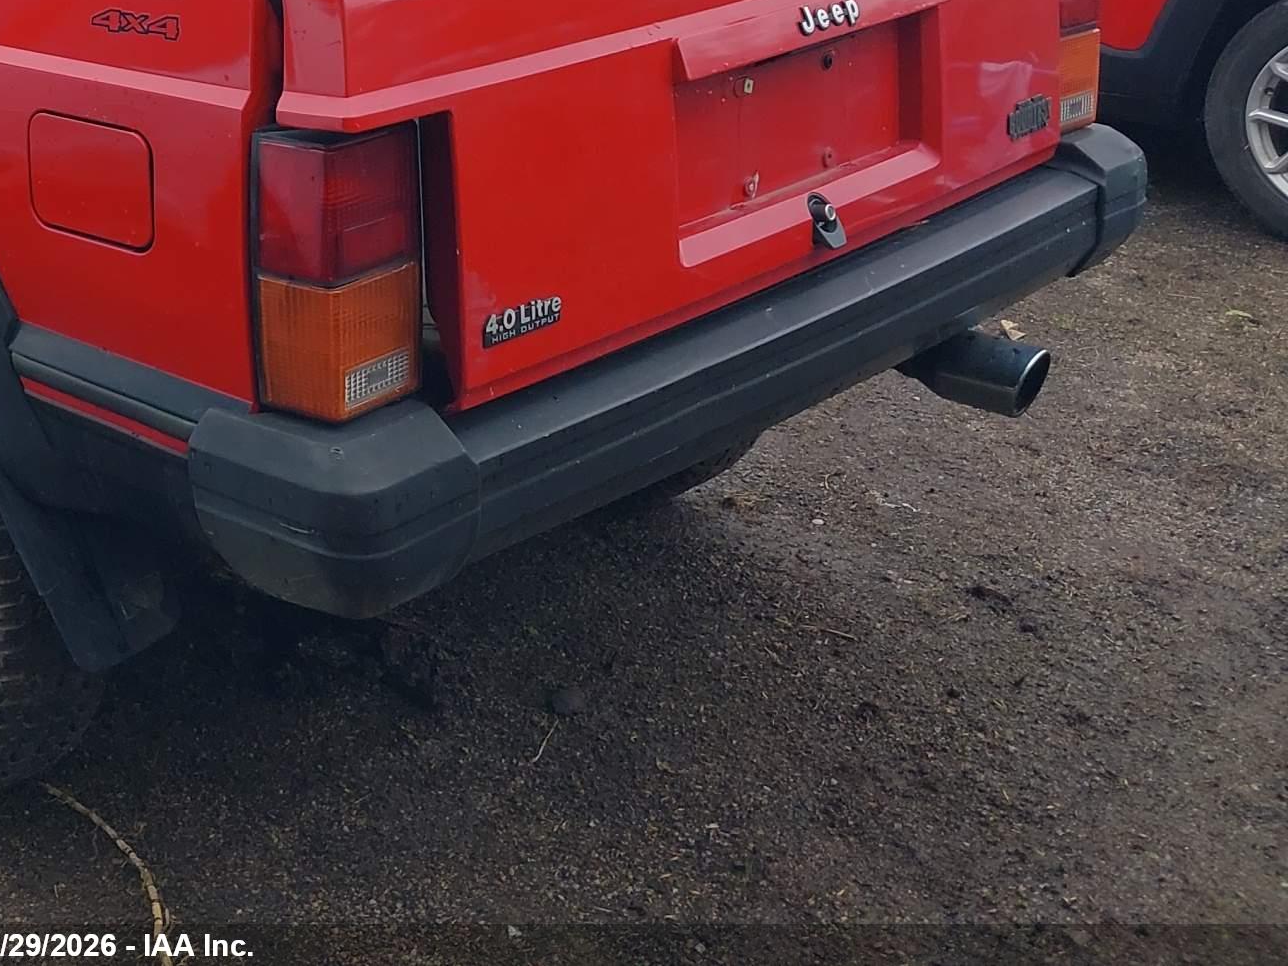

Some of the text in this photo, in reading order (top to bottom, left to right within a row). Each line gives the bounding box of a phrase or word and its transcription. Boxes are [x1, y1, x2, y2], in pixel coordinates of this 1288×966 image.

[486, 296, 562, 335] 4.0 Litre
[491, 313, 560, 344] HIGH OUTPUT
